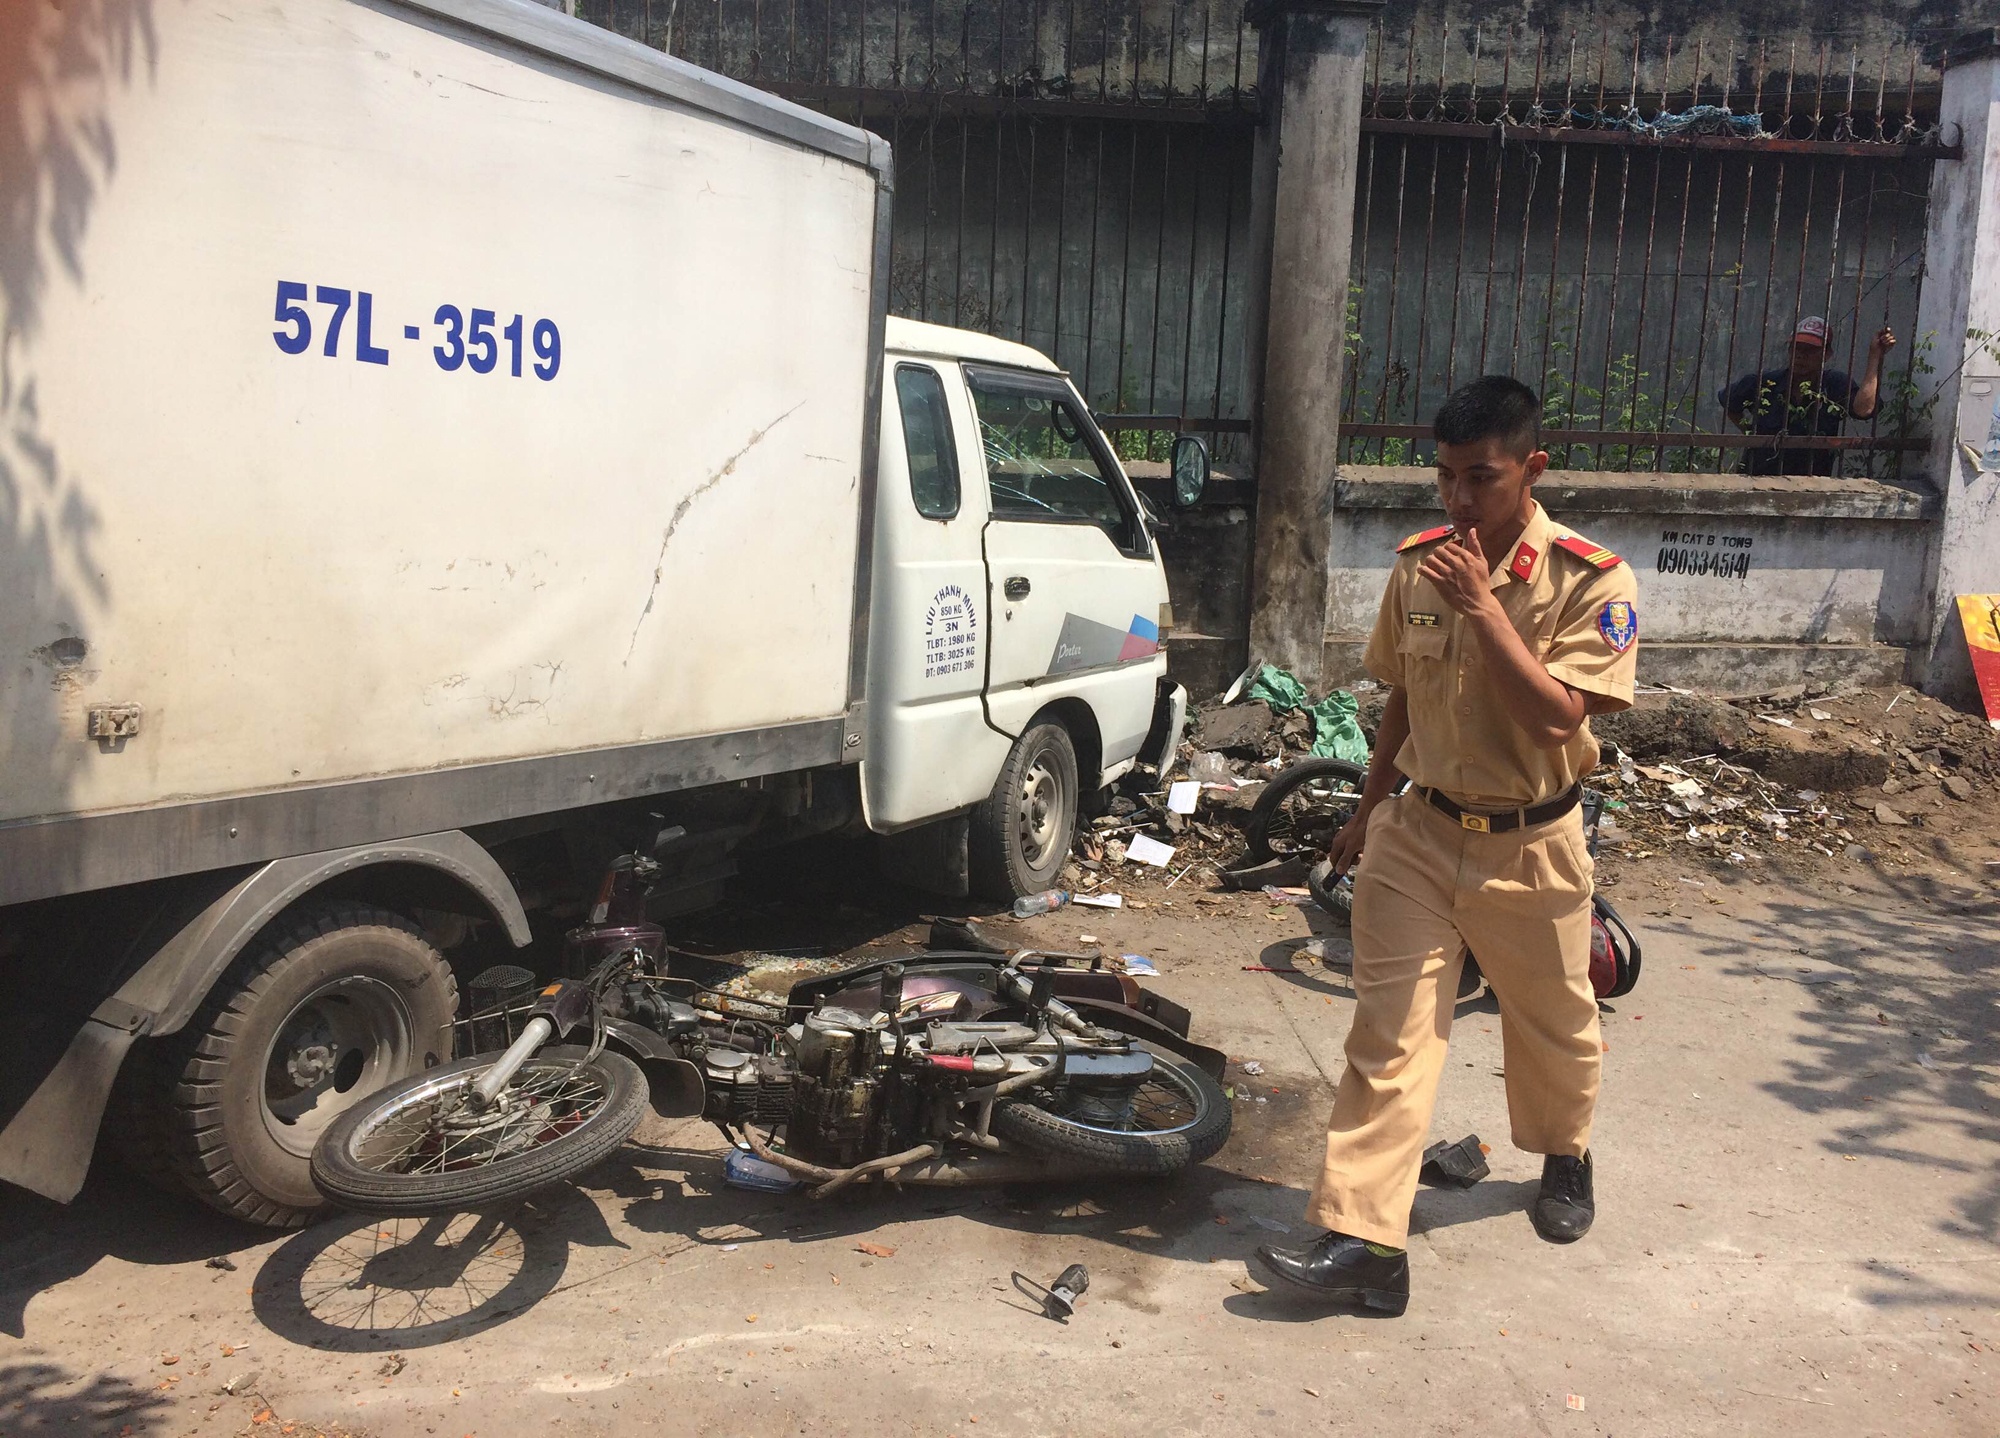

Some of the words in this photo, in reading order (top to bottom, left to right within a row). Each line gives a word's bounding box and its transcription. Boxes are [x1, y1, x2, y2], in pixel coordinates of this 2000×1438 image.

[273, 280, 389, 366] 57L
[433, 304, 561, 381] 3519
[1681, 533, 1704, 545] CAT
[1706, 535, 1715, 546] B
[933, 584, 962, 605] THANH
[962, 593, 977, 628] MINH
[940, 605, 953, 617] 850
[953, 604, 962, 614] KG
[945, 621, 959, 632] 3N
[926, 637, 947, 650] TLBT:
[966, 632, 976, 643] KG
[926, 652, 946, 664] TLTB:
[947, 648, 965, 660] 3025
[966, 646, 975, 656] KG
[936, 664, 951, 676] 0903
[952, 662, 962, 673] 671
